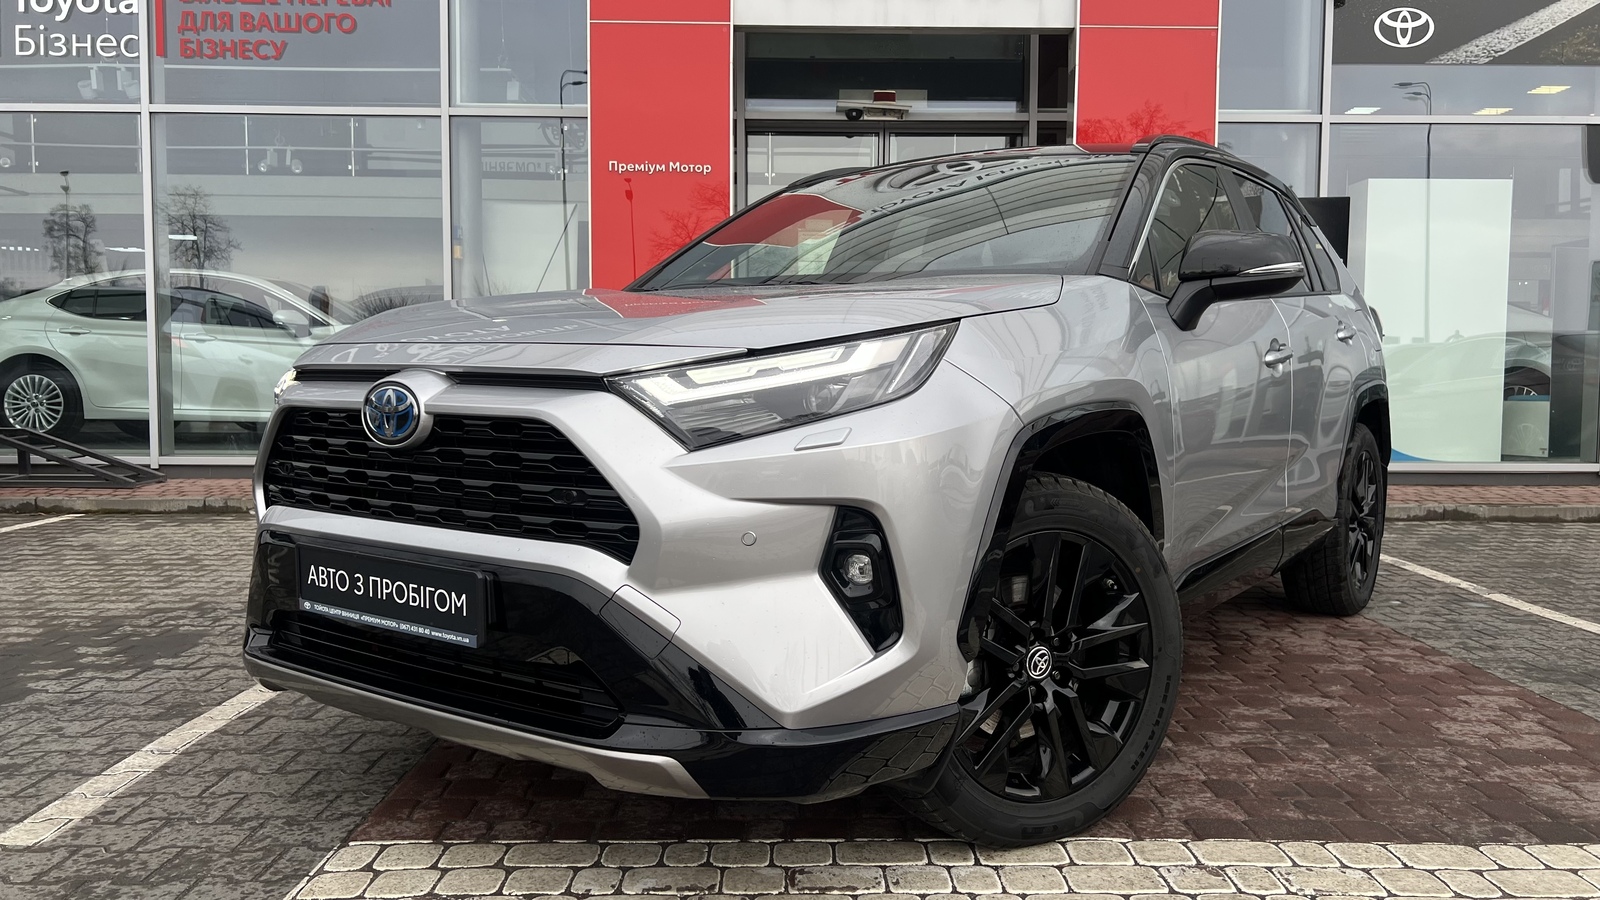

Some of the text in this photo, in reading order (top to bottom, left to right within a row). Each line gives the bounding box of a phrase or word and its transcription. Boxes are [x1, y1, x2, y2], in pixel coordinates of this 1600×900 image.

[177, 11, 357, 34] ДЛЯ ВАШОГО
[15, 25, 139, 57] Бізнес
[179, 38, 287, 59] БІЗНЕСУ
[608, 160, 712, 175] Преміум Мотор
[307, 564, 467, 617] АВТО З ПРОБІГОМ
